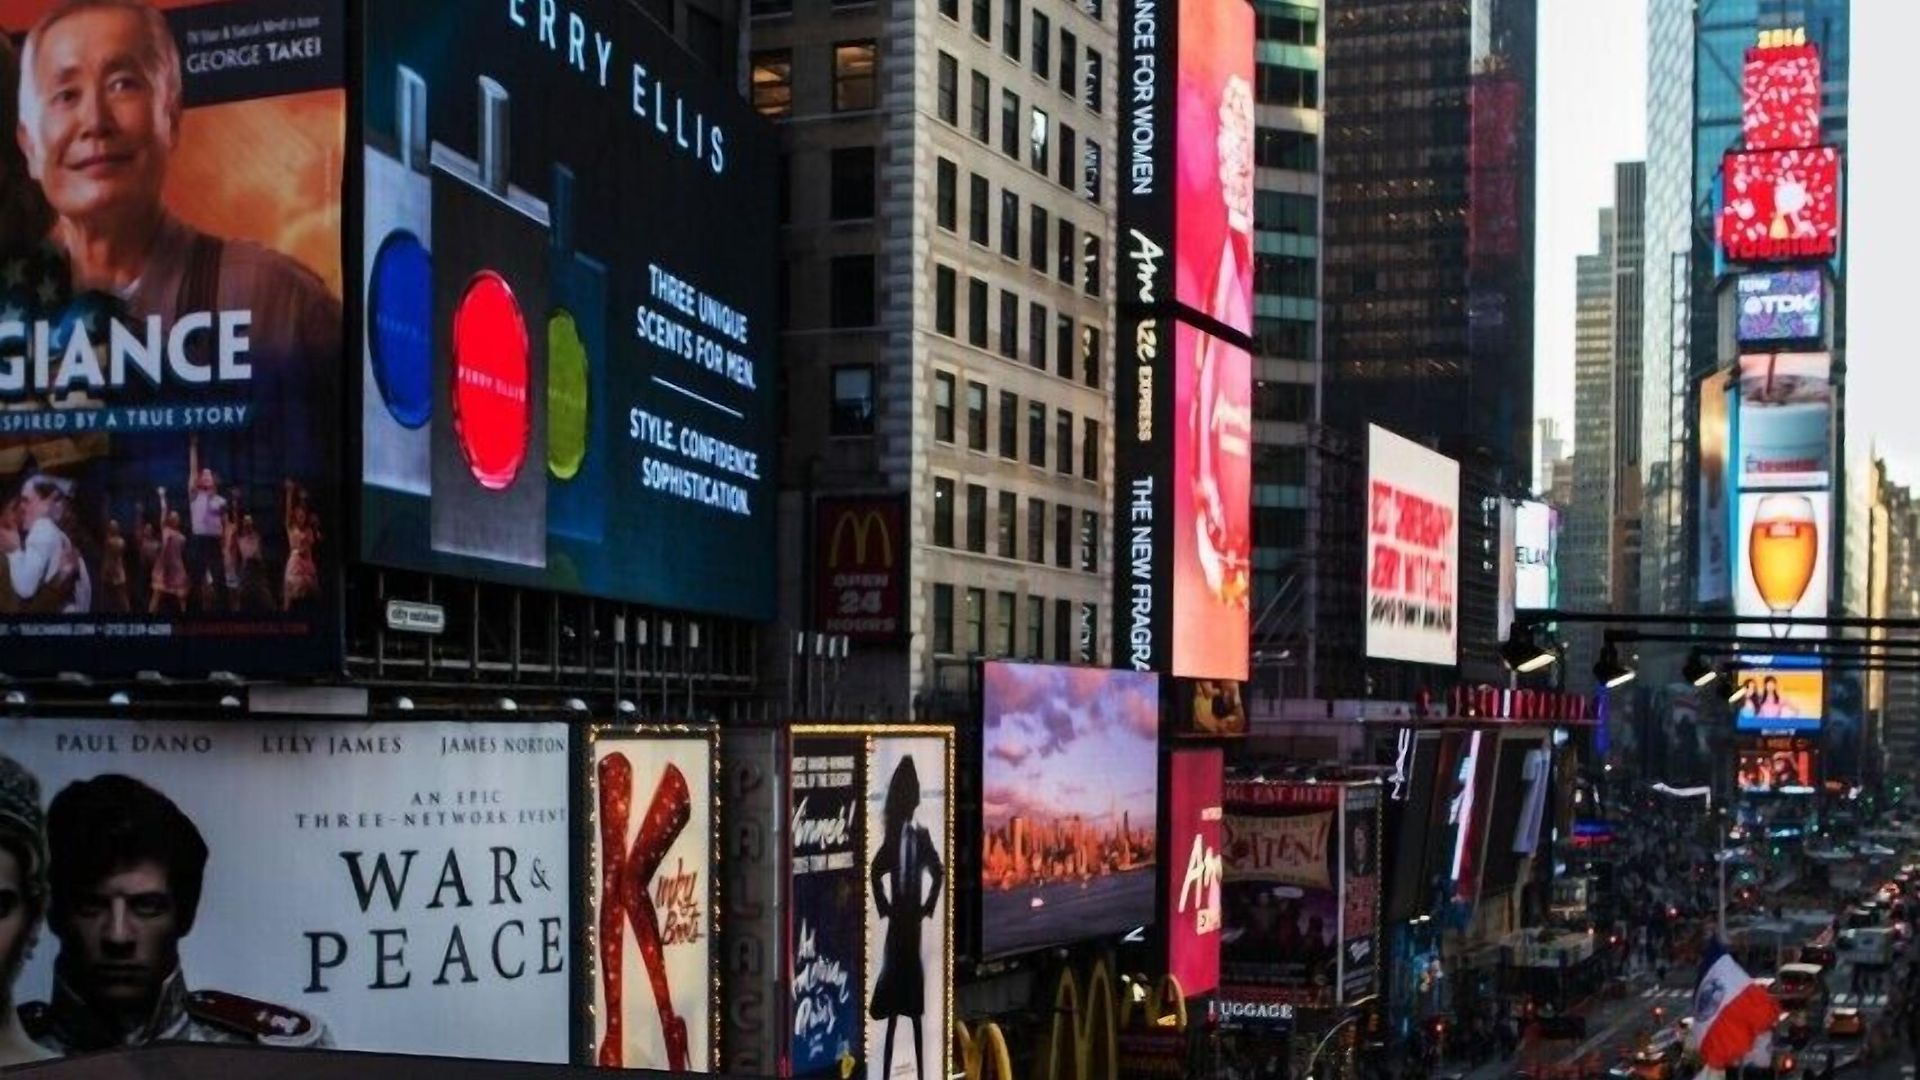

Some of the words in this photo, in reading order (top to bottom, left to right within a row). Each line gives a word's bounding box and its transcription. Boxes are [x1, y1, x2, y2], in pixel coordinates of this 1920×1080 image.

[187, 44, 260, 73] GEORGE
[265, 37, 321, 62] TAKEI
[1133, 53, 1155, 102] FOR
[633, 62, 723, 174] ELLIS
[1131, 104, 1155, 195] WOMEN
[1727, 235, 1836, 258] TOSHIBA
[648, 262, 696, 317] THREE
[697, 291, 748, 344] UNIQUE
[1760, 294, 1820, 314] TDK
[637, 305, 693, 360] SCENTS
[695, 334, 724, 374] FOR
[726, 350, 757, 391] MEN.
[75, 411, 97, 429] BY
[106, 410, 118, 426] A
[126, 407, 174, 426] TRUE
[184, 405, 247, 425] STORY
[1131, 475, 1153, 523] THE
[1130, 526, 1153, 580] NEW
[833, 573, 889, 588] OPEN
[838, 590, 881, 614] 24
[827, 617, 896, 633] HOURS
[56, 735, 118, 752] PAUL
[132, 735, 213, 753] DANO
[262, 736, 315, 754] LILY
[329, 736, 402, 756] JAMES
[441, 736, 497, 756] JAMES
[503, 737, 566, 754] NORTON
[411, 792, 441, 806] AN
[457, 790, 501, 804] EPIC
[296, 811, 507, 829] THREE-NETWORK
[520, 808, 567, 824] EVENT
[338, 846, 522, 913] WAR
[530, 856, 552, 893] &
[303, 917, 564, 994] PEACE
